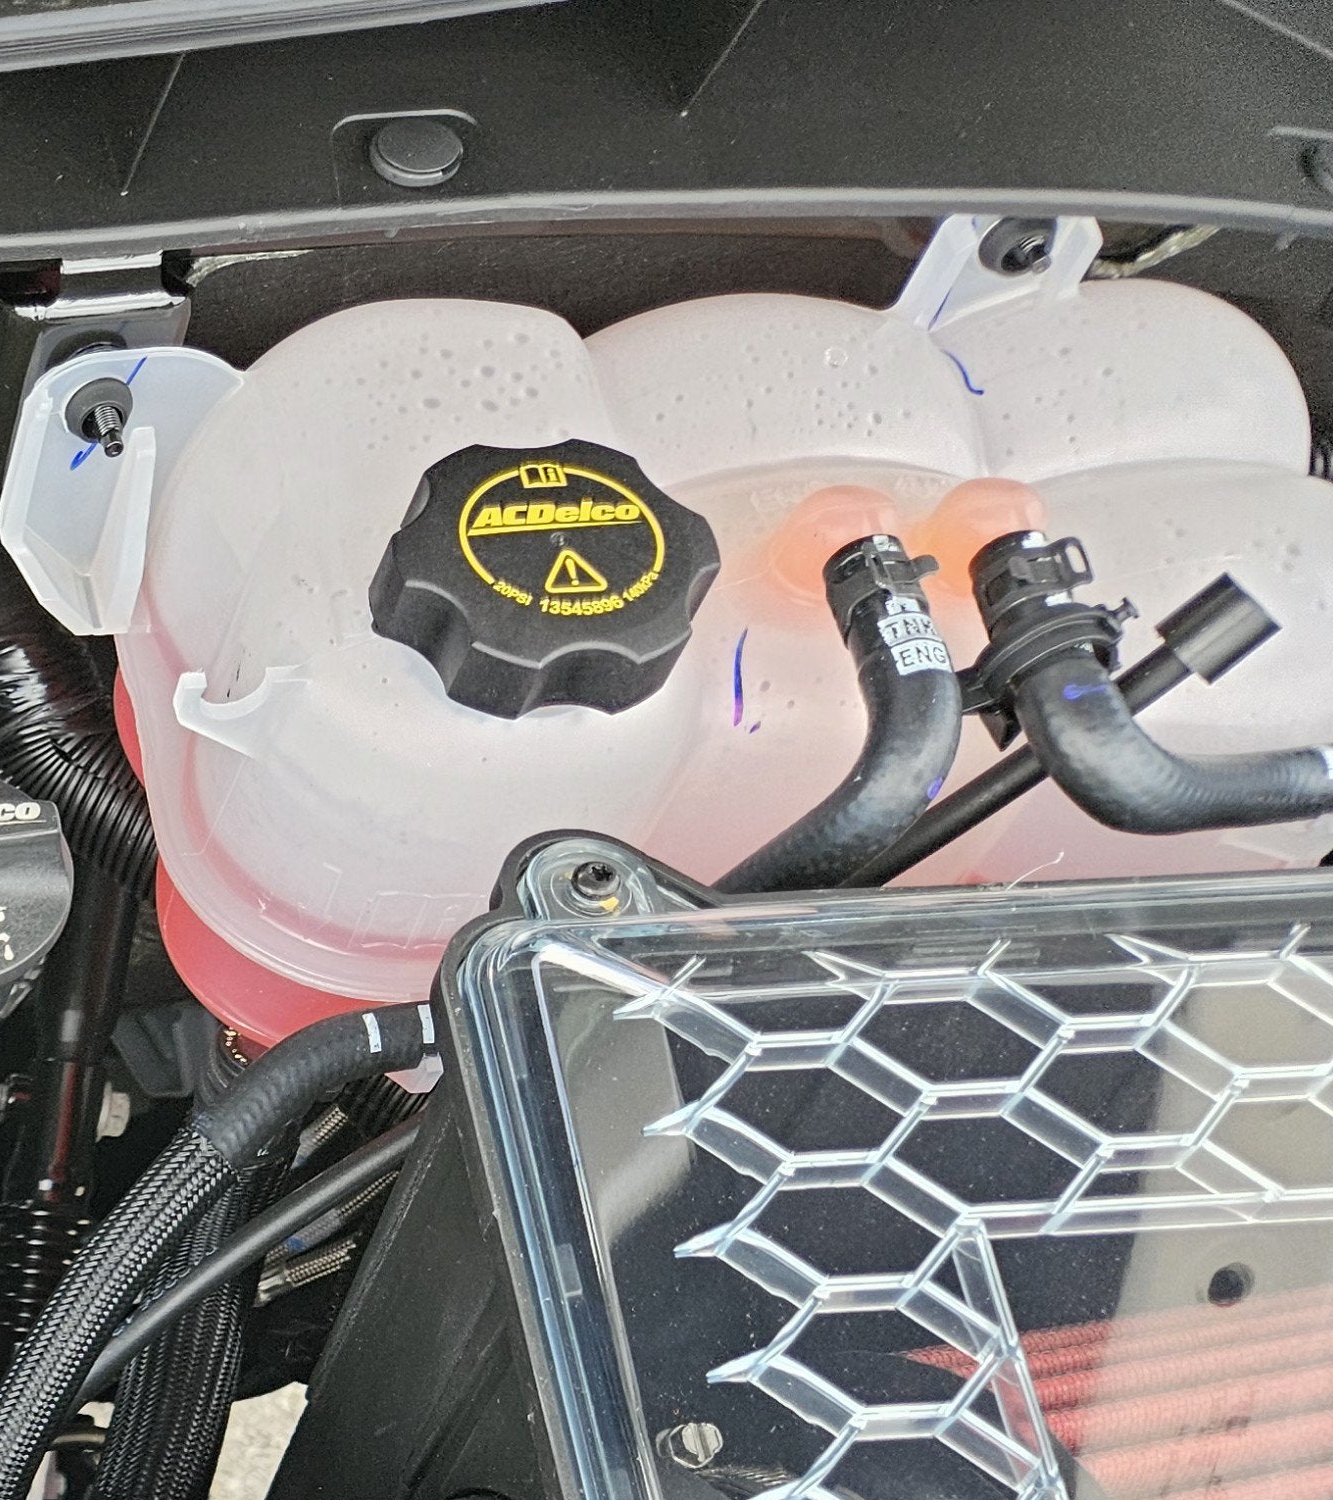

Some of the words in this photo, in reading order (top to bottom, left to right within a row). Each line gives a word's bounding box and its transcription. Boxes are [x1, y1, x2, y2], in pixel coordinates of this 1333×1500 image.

[473, 500, 640, 529] ACDelco
[492, 581, 533, 607] 20PSI
[539, 596, 625, 616] 13545896
[899, 645, 948, 668] ENG
